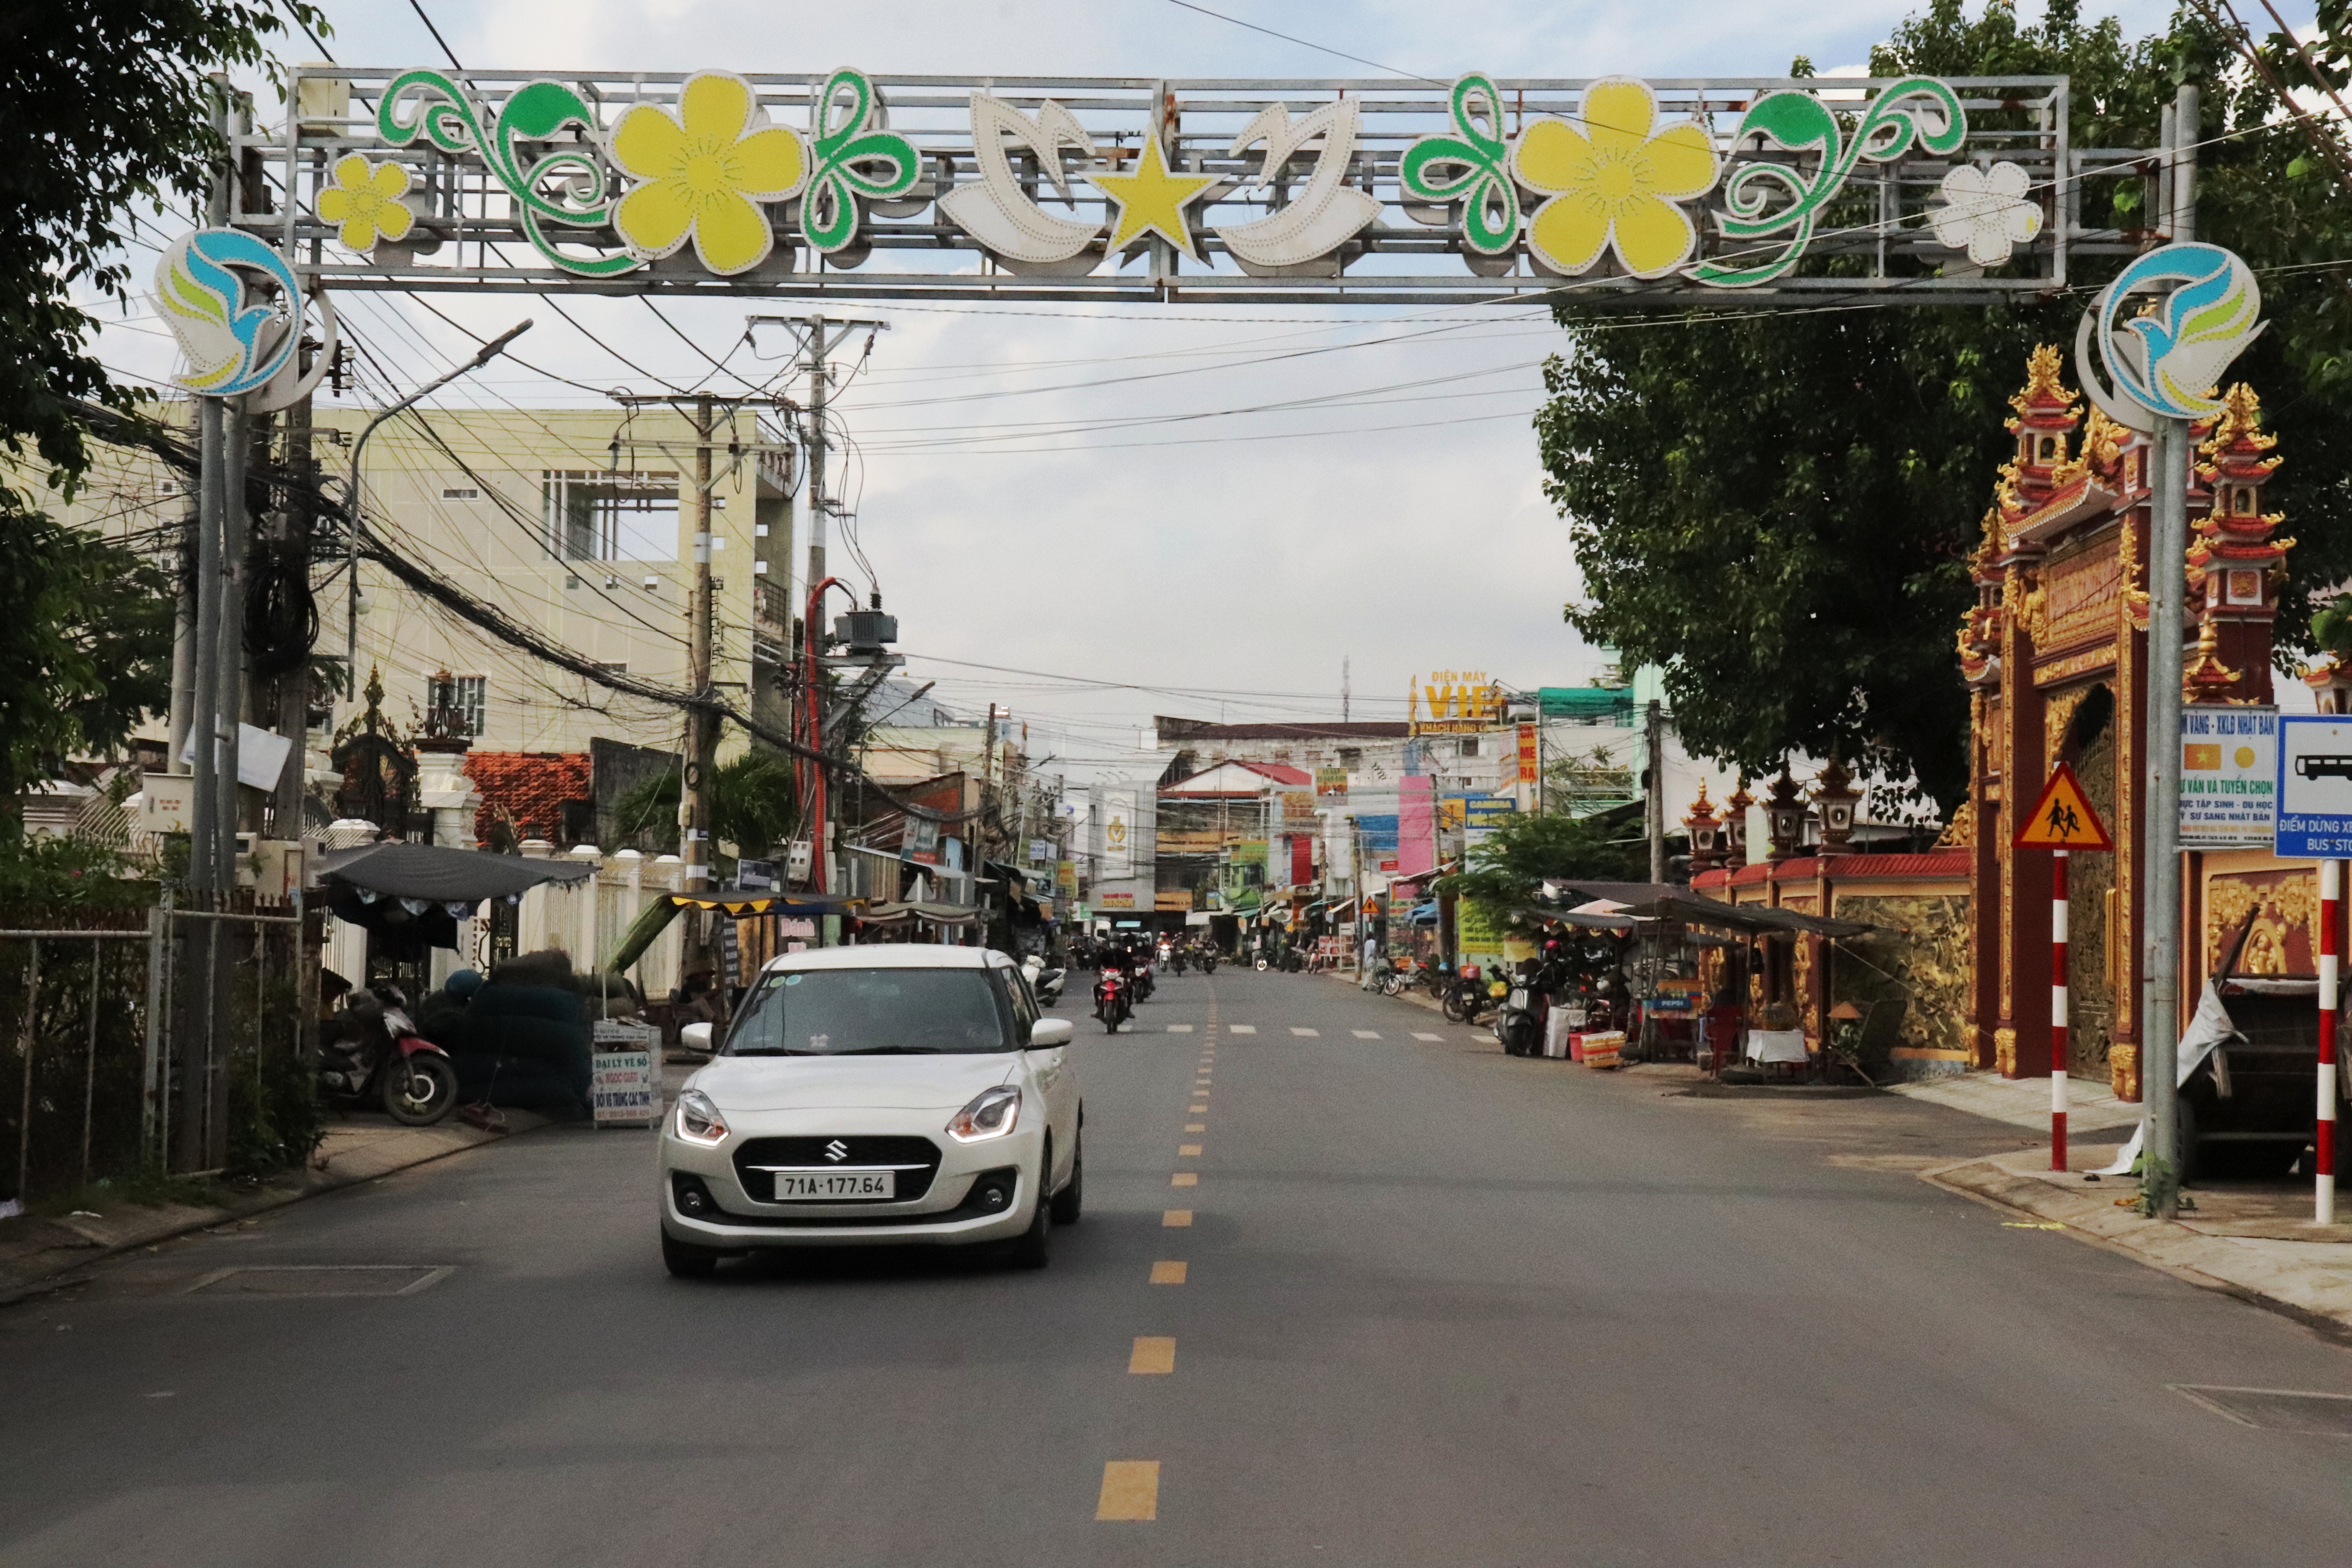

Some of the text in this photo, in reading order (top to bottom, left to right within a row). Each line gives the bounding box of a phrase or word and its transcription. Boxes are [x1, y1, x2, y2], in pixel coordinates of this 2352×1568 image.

[1432, 669, 1486, 684] ĐIỆN MÁY
[2190, 711, 2209, 734] VÀNG
[1520, 747, 1536, 759] ME
[1520, 767, 1536, 779] RA
[2188, 775, 2204, 793] VẤN
[2207, 777, 2218, 793] VÀ
[2220, 774, 2247, 794] TUYỂN
[2249, 780, 2273, 798] CHỌN
[2196, 799, 2211, 810] TẬP
[2256, 801, 2272, 810] HỌC
[2190, 812, 2201, 820] SƯ
[2253, 811, 2270, 821] BẢN
[2279, 815, 2306, 832] ĐIỂM
[2308, 816, 2339, 833] DỪNG
[2307, 838, 2329, 851] BUS
[781, 918, 815, 937] Bánh
[637, 1054, 647, 1066] SỐ
[785, 1178, 884, 1194] 71A-177.64
